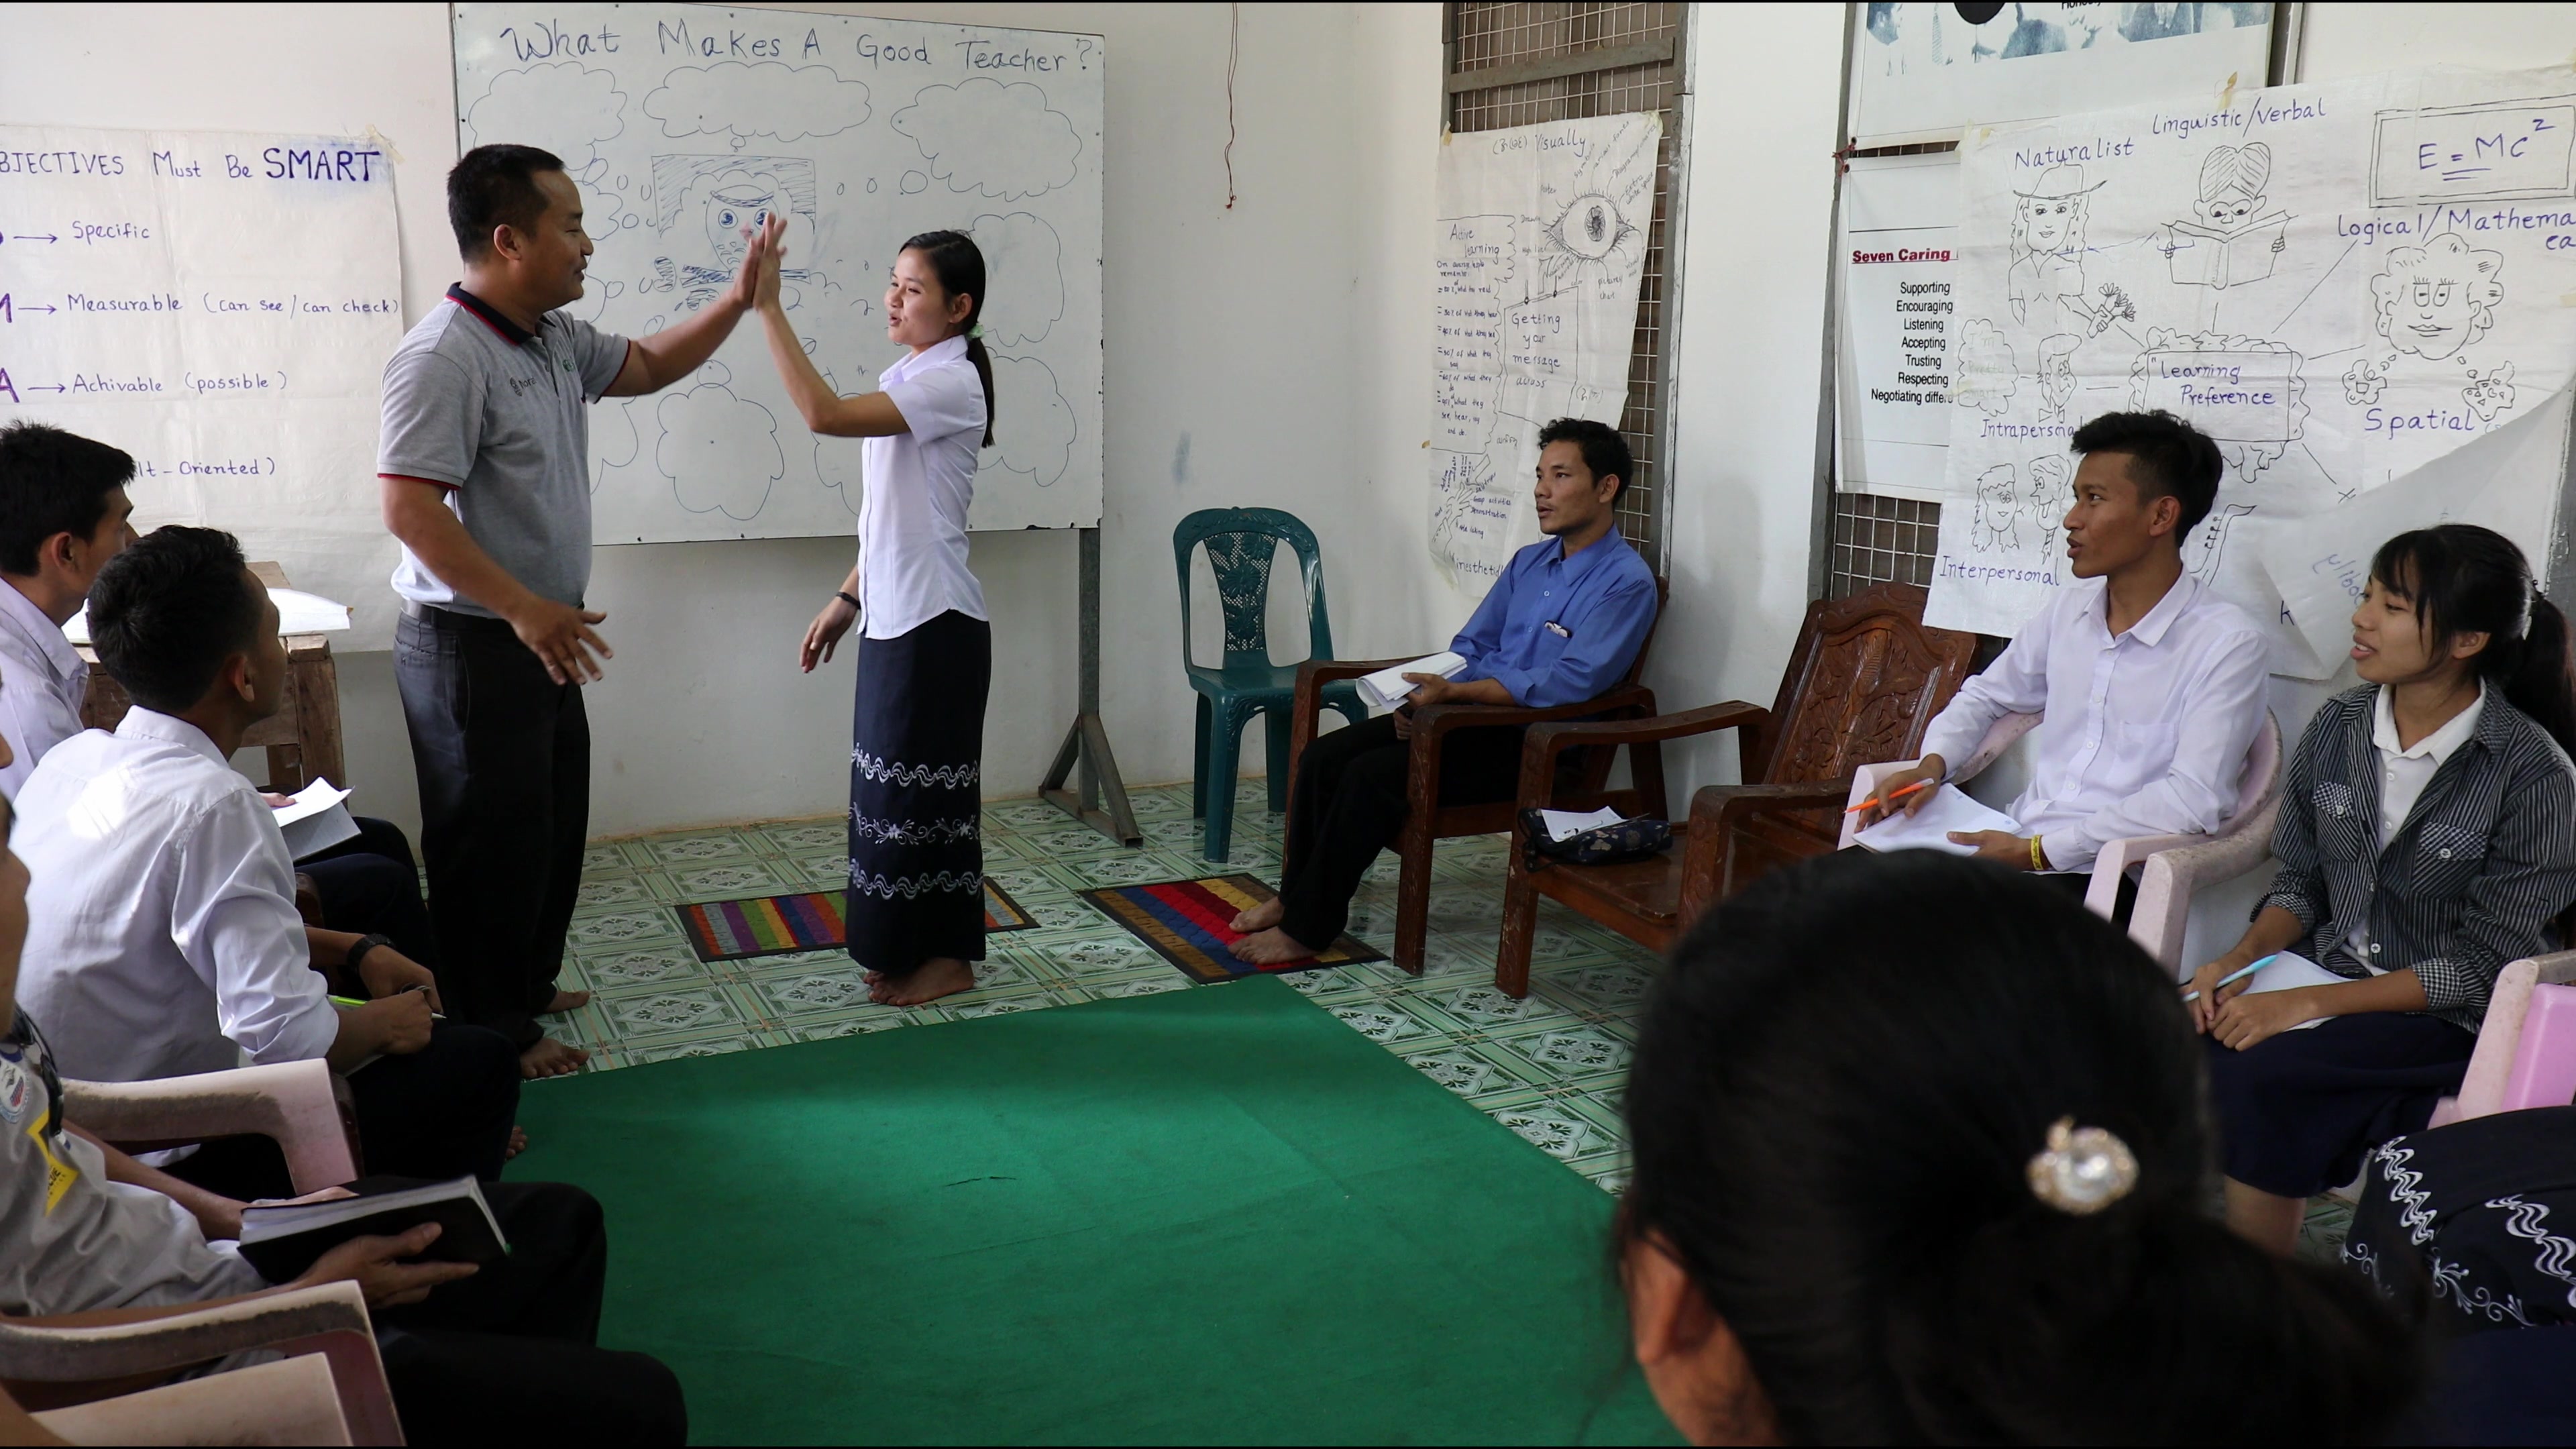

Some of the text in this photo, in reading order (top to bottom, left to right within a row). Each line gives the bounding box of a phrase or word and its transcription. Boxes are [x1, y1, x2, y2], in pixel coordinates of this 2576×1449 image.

[500, 18, 621, 62] What
[659, 18, 781, 59] Makes
[802, 28, 821, 59] A
[856, 34, 932, 70] Good
[2015, 138, 2135, 170] Naturalist
[153, 151, 201, 178] Must
[226, 155, 253, 178] Be
[263, 148, 380, 182] SMART
[72, 221, 150, 245] Specific
[1852, 248, 1950, 263] Seven Caring
[1900, 282, 1950, 296] Supporting
[67, 293, 183, 311] Measurable
[303, 302, 331, 313] can
[343, 299, 398, 313] check)
[1896, 300, 1953, 314] Encouraging
[1511, 313, 1560, 333] Getting
[1904, 318, 1944, 332] Listening
[1901, 336, 1946, 351] Accepting
[1513, 355, 1560, 374] message
[1905, 354, 1941, 370] Trusting
[72, 374, 163, 394] Achivable
[1898, 372, 1948, 388] Respecting
[1871, 388, 1922, 406] Negotiating
[2180, 384, 2275, 406] Preference
[2364, 408, 2475, 440] Spatial
[1939, 555, 2060, 586] Interpersonal
